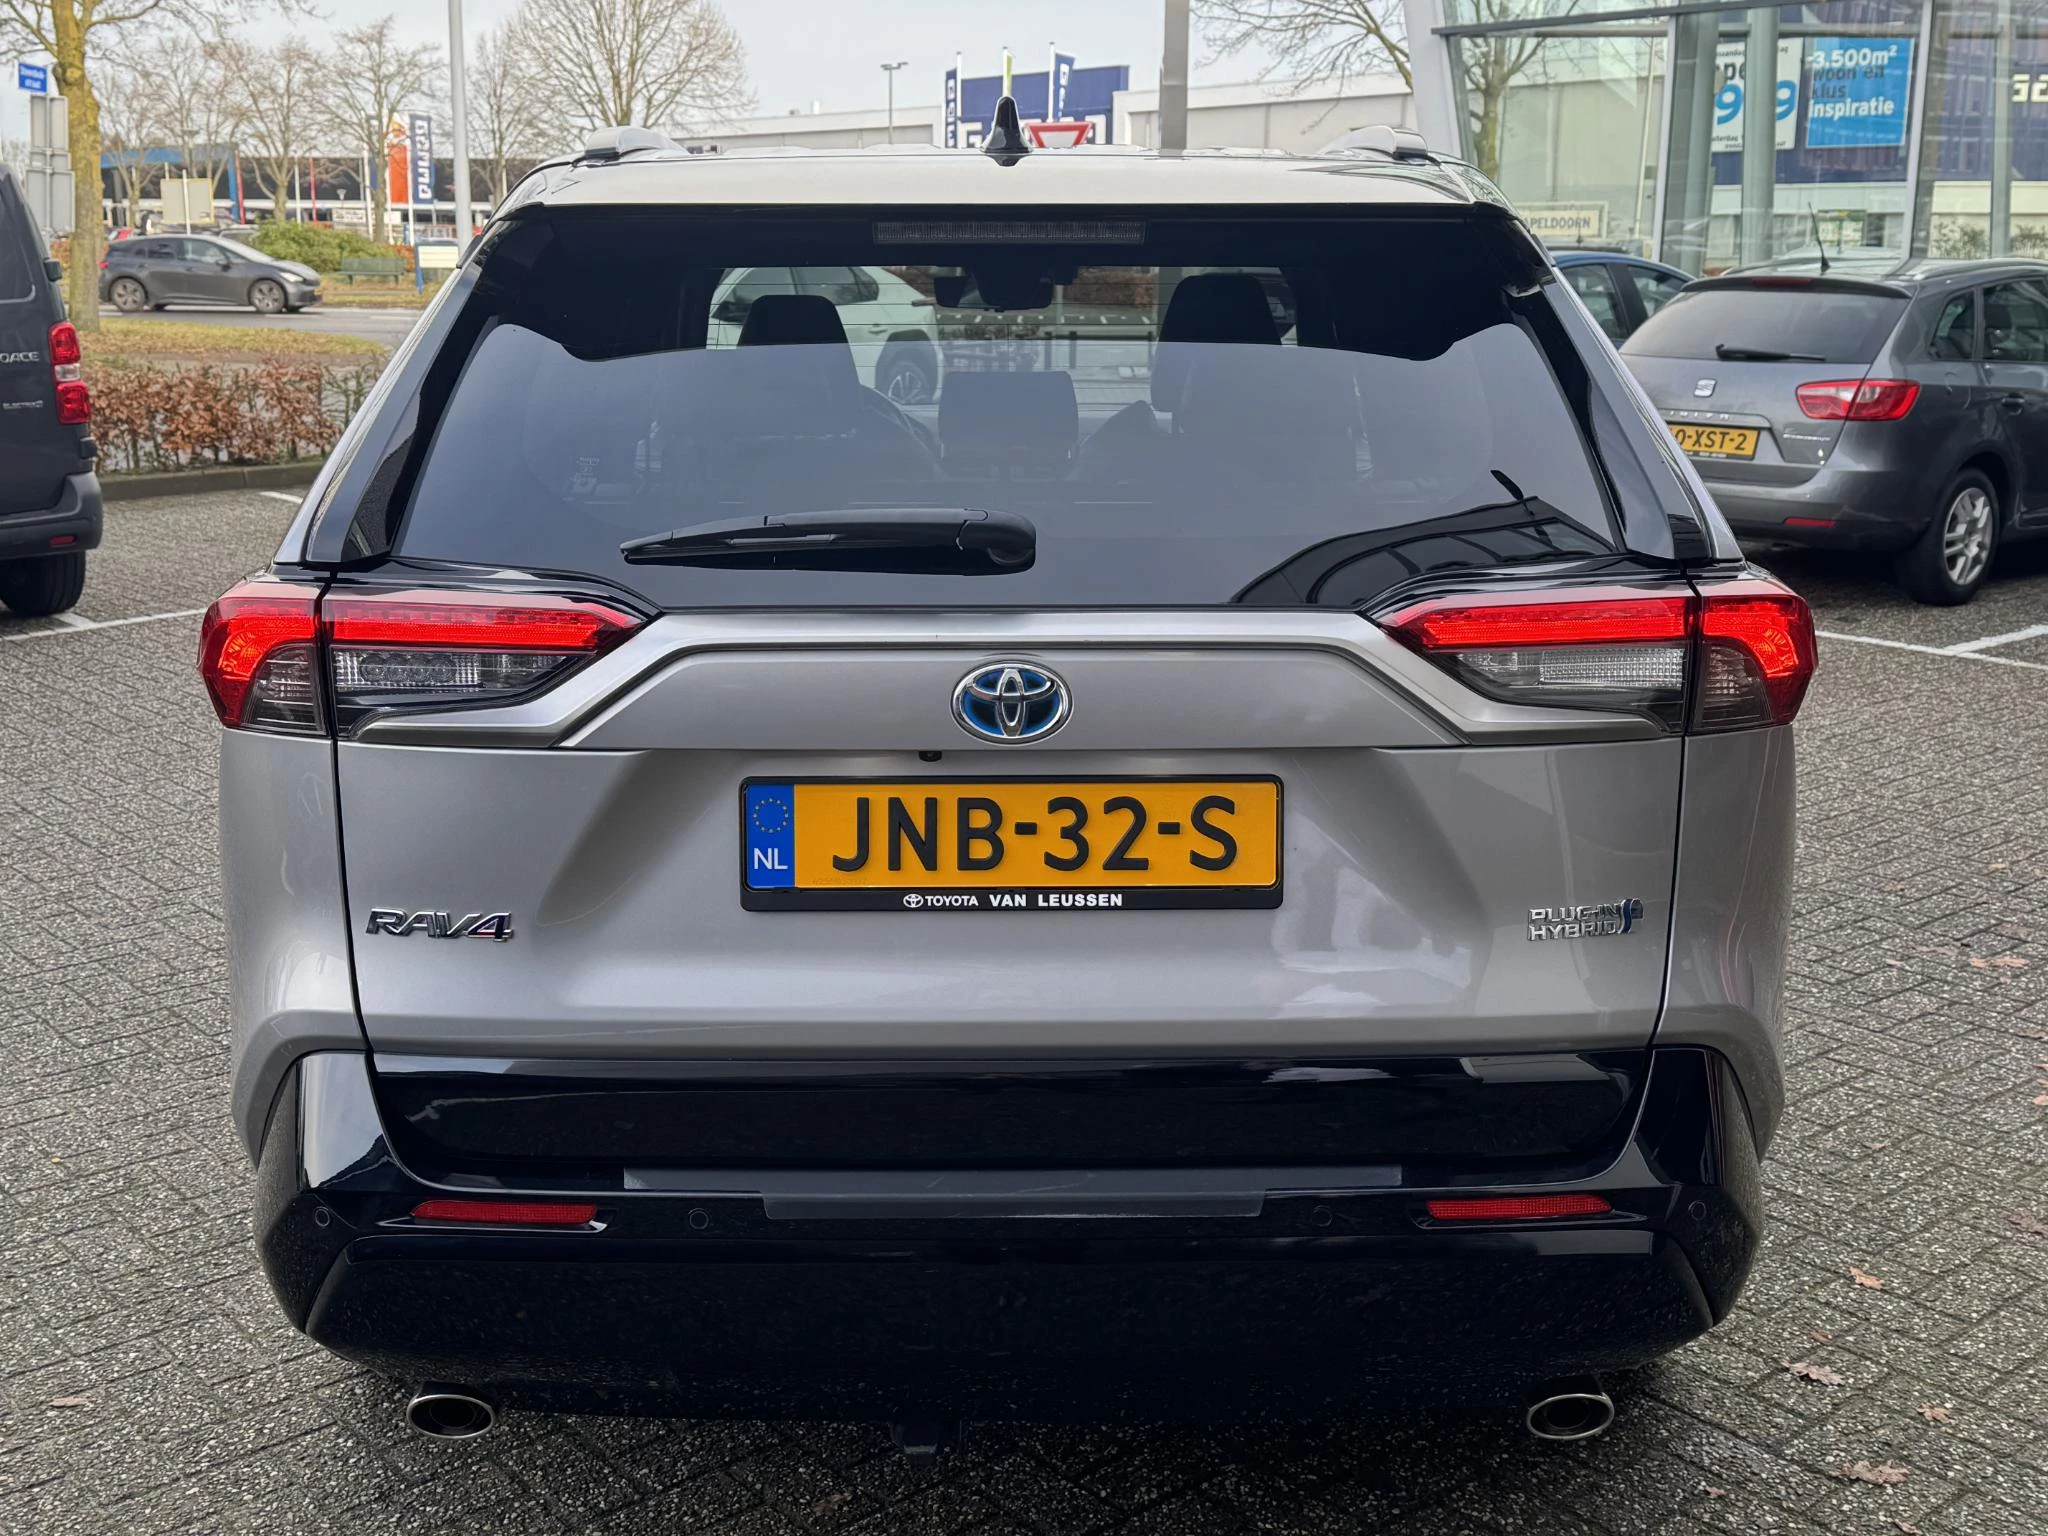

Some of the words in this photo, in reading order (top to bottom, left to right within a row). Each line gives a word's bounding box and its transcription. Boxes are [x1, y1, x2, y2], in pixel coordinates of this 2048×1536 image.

[1814, 67, 1856, 80] woon
[1864, 66, 1885, 78] en
[1810, 97, 1894, 120] inspiratie
[1670, 427, 1748, 451] 0-XST-2
[831, 795, 1239, 873] JNB-32-S
[752, 847, 788, 871] NL
[925, 895, 979, 908] TOYOTA
[988, 893, 1027, 908] VAN
[1037, 893, 1123, 908] LEUSSEN
[1528, 903, 1622, 922] PLUG-IN
[365, 907, 515, 942] RAV4
[1527, 920, 1618, 942] HYBRID
